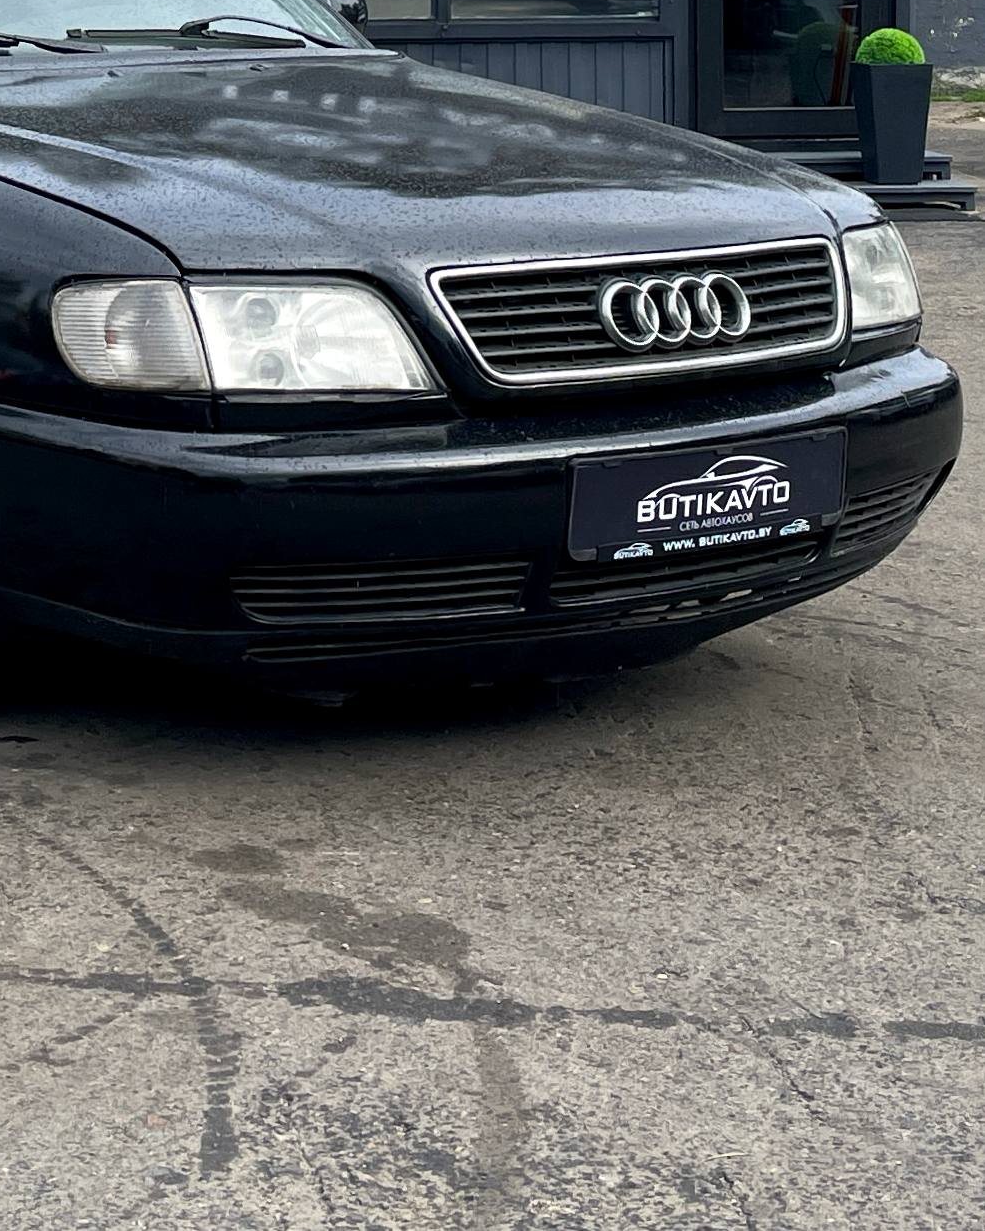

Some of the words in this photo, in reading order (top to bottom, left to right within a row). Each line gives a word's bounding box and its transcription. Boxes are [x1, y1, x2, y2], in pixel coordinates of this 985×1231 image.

[636, 479, 791, 523] BUTIKAVTO
[663, 540, 696, 552] WWW.
[698, 526, 773, 548] BUTIKAVTO.BY
[679, 520, 700, 532] СЕТЬ
